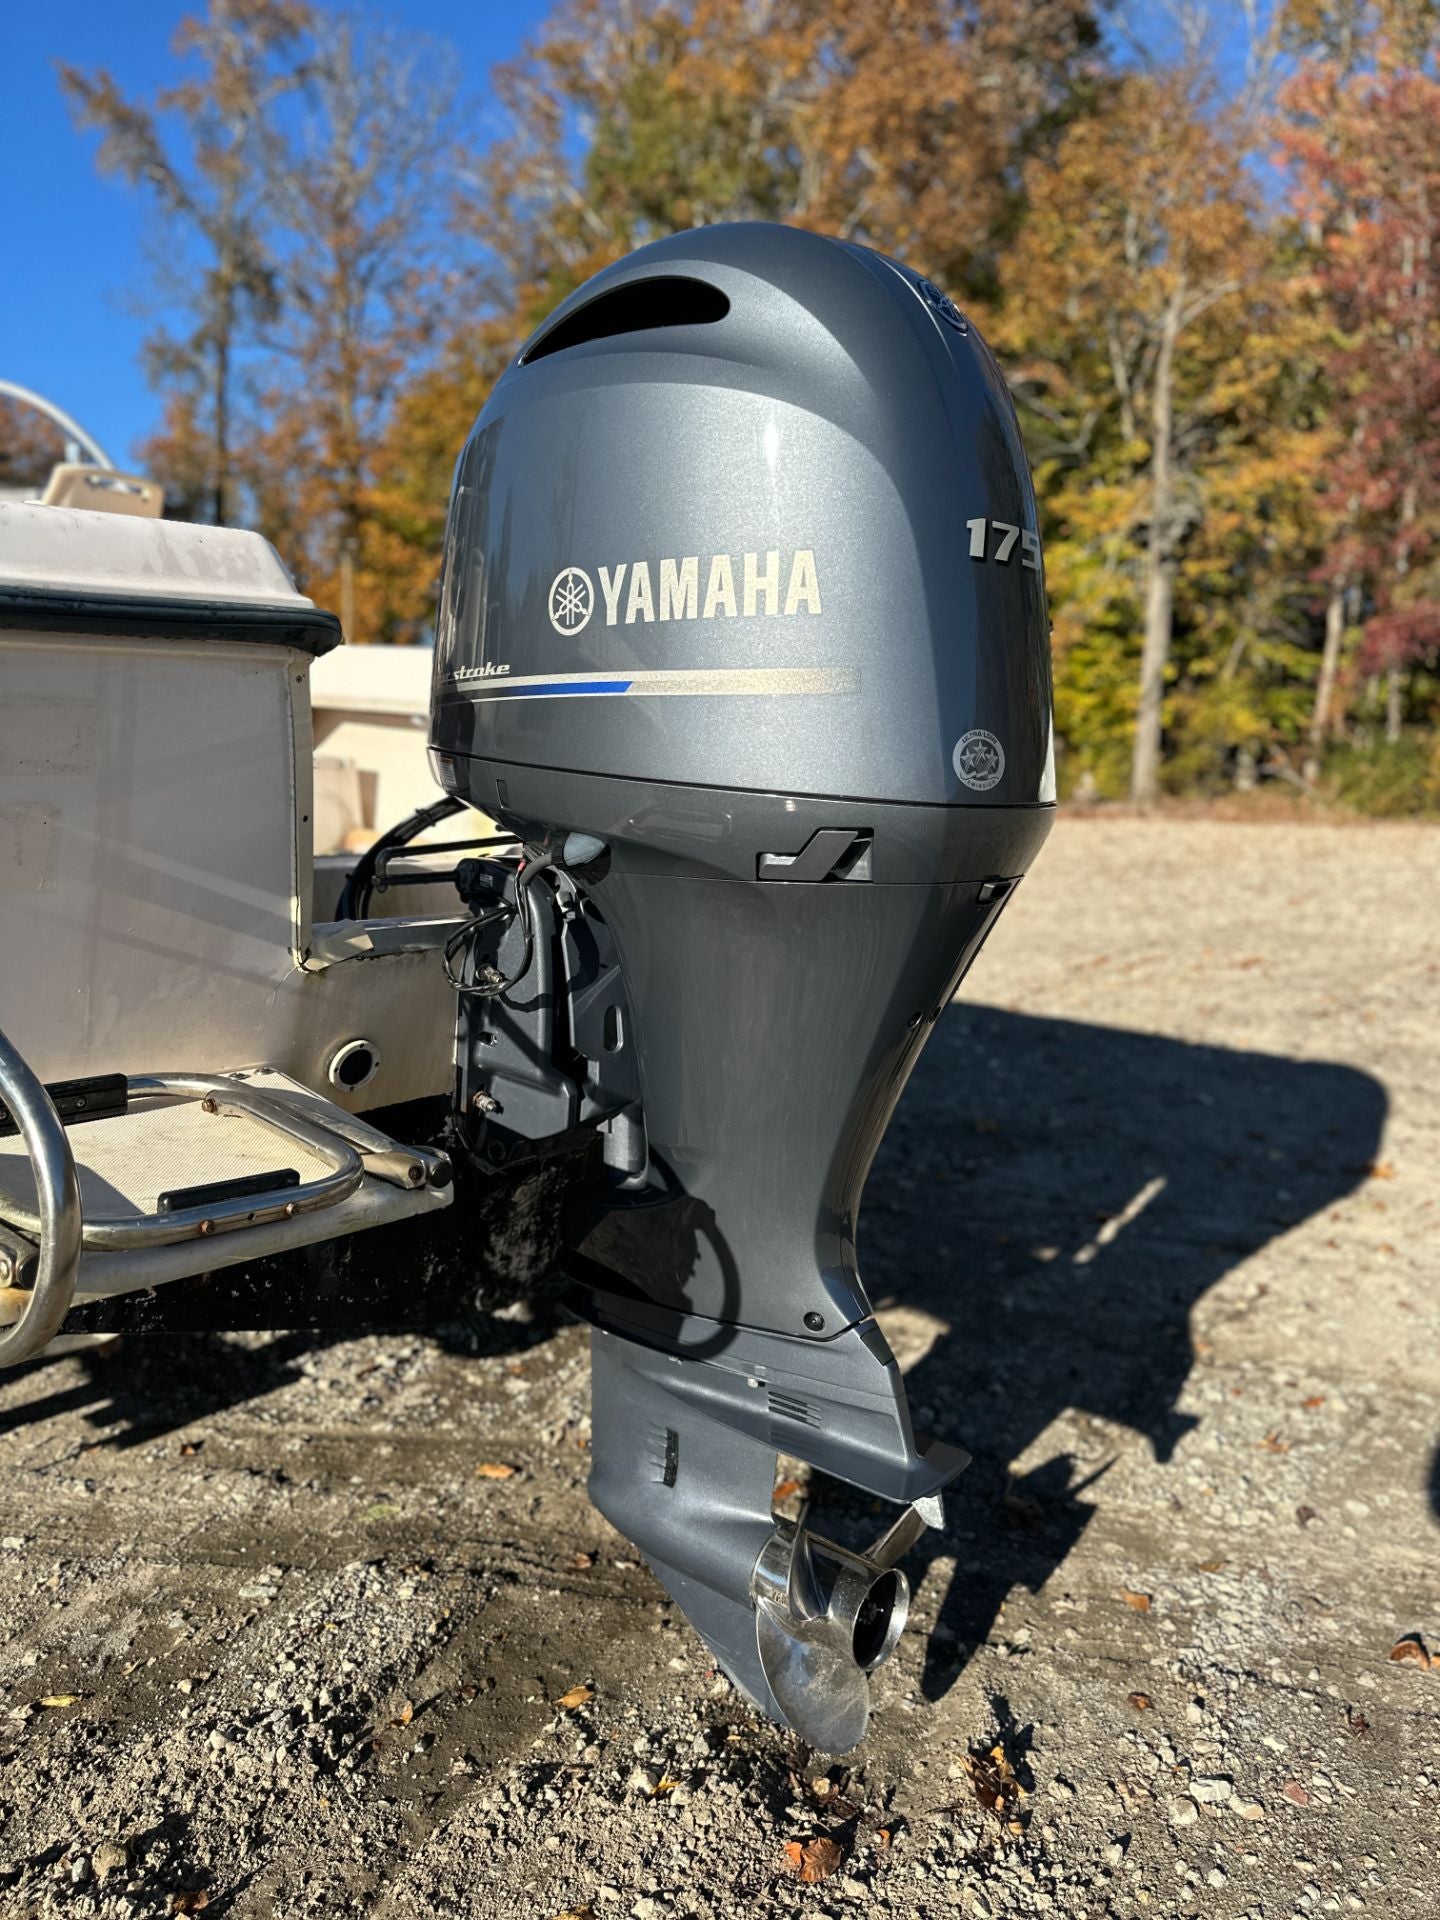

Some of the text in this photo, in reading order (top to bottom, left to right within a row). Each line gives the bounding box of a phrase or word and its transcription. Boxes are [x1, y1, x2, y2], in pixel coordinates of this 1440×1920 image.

[966, 518, 1041, 570] 175
[597, 550, 822, 626] YAMAHA
[454, 661, 511, 681] stroke
